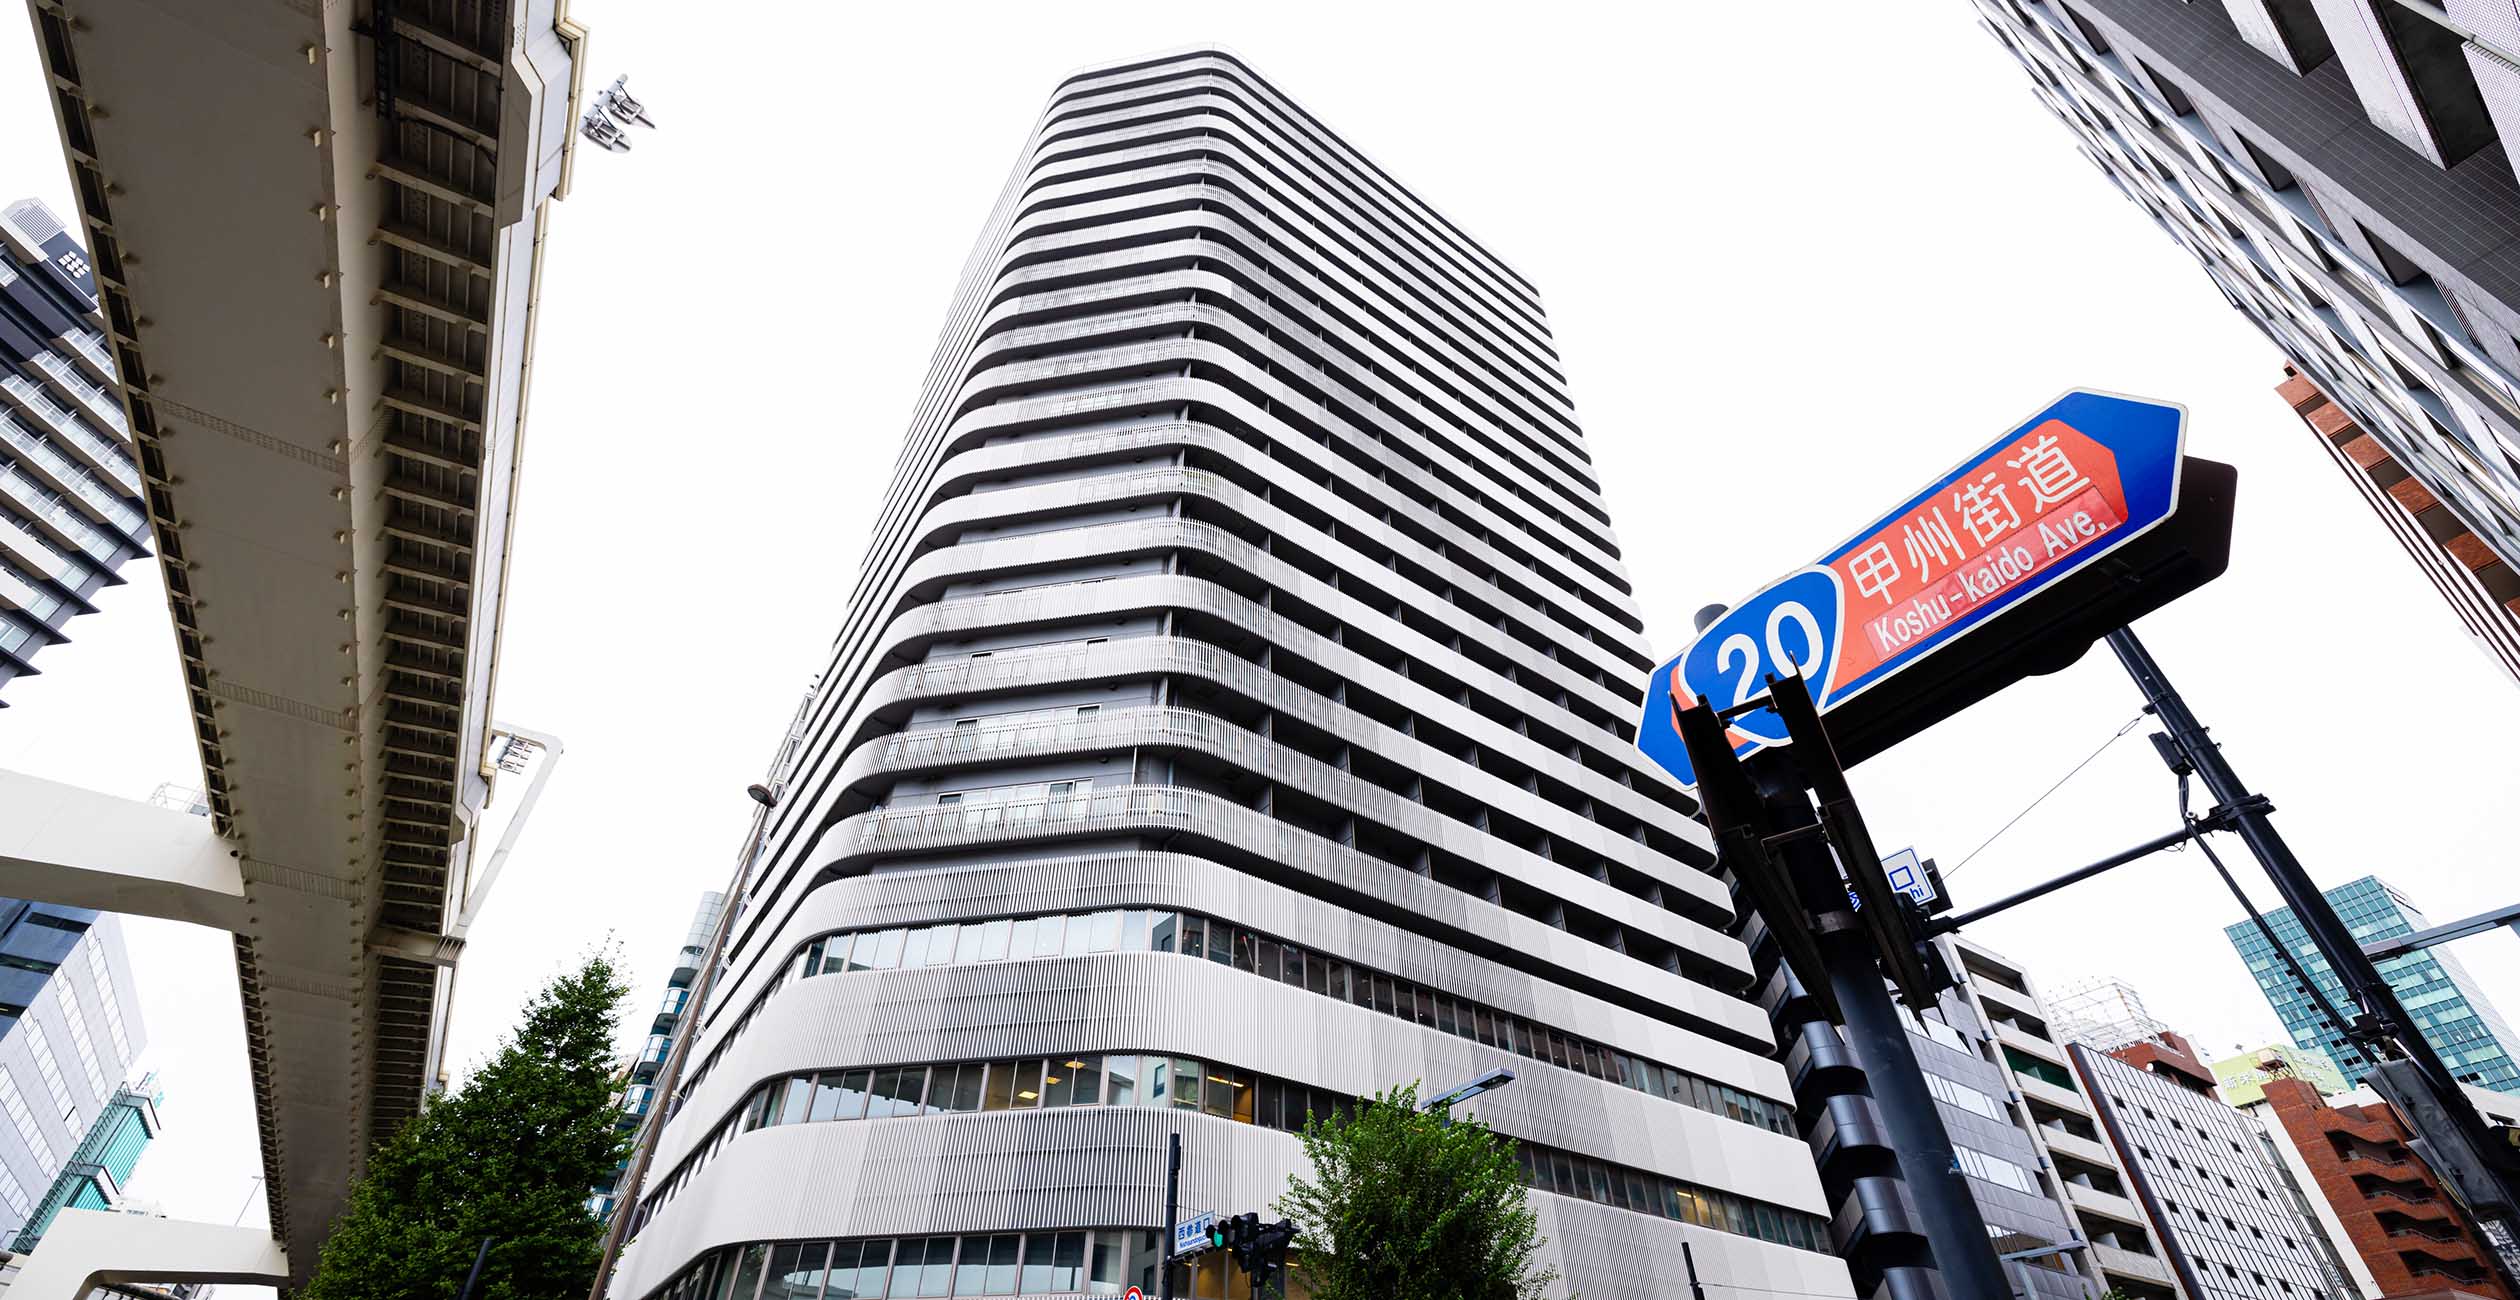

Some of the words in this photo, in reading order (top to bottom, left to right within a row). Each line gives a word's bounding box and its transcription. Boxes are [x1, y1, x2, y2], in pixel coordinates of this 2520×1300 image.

[1849, 435, 2090, 605] 甲州街道
[1873, 545, 2035, 652] Koshu-kaido
[2038, 510, 2108, 559] Ave.
[1717, 601, 1824, 722] 20
